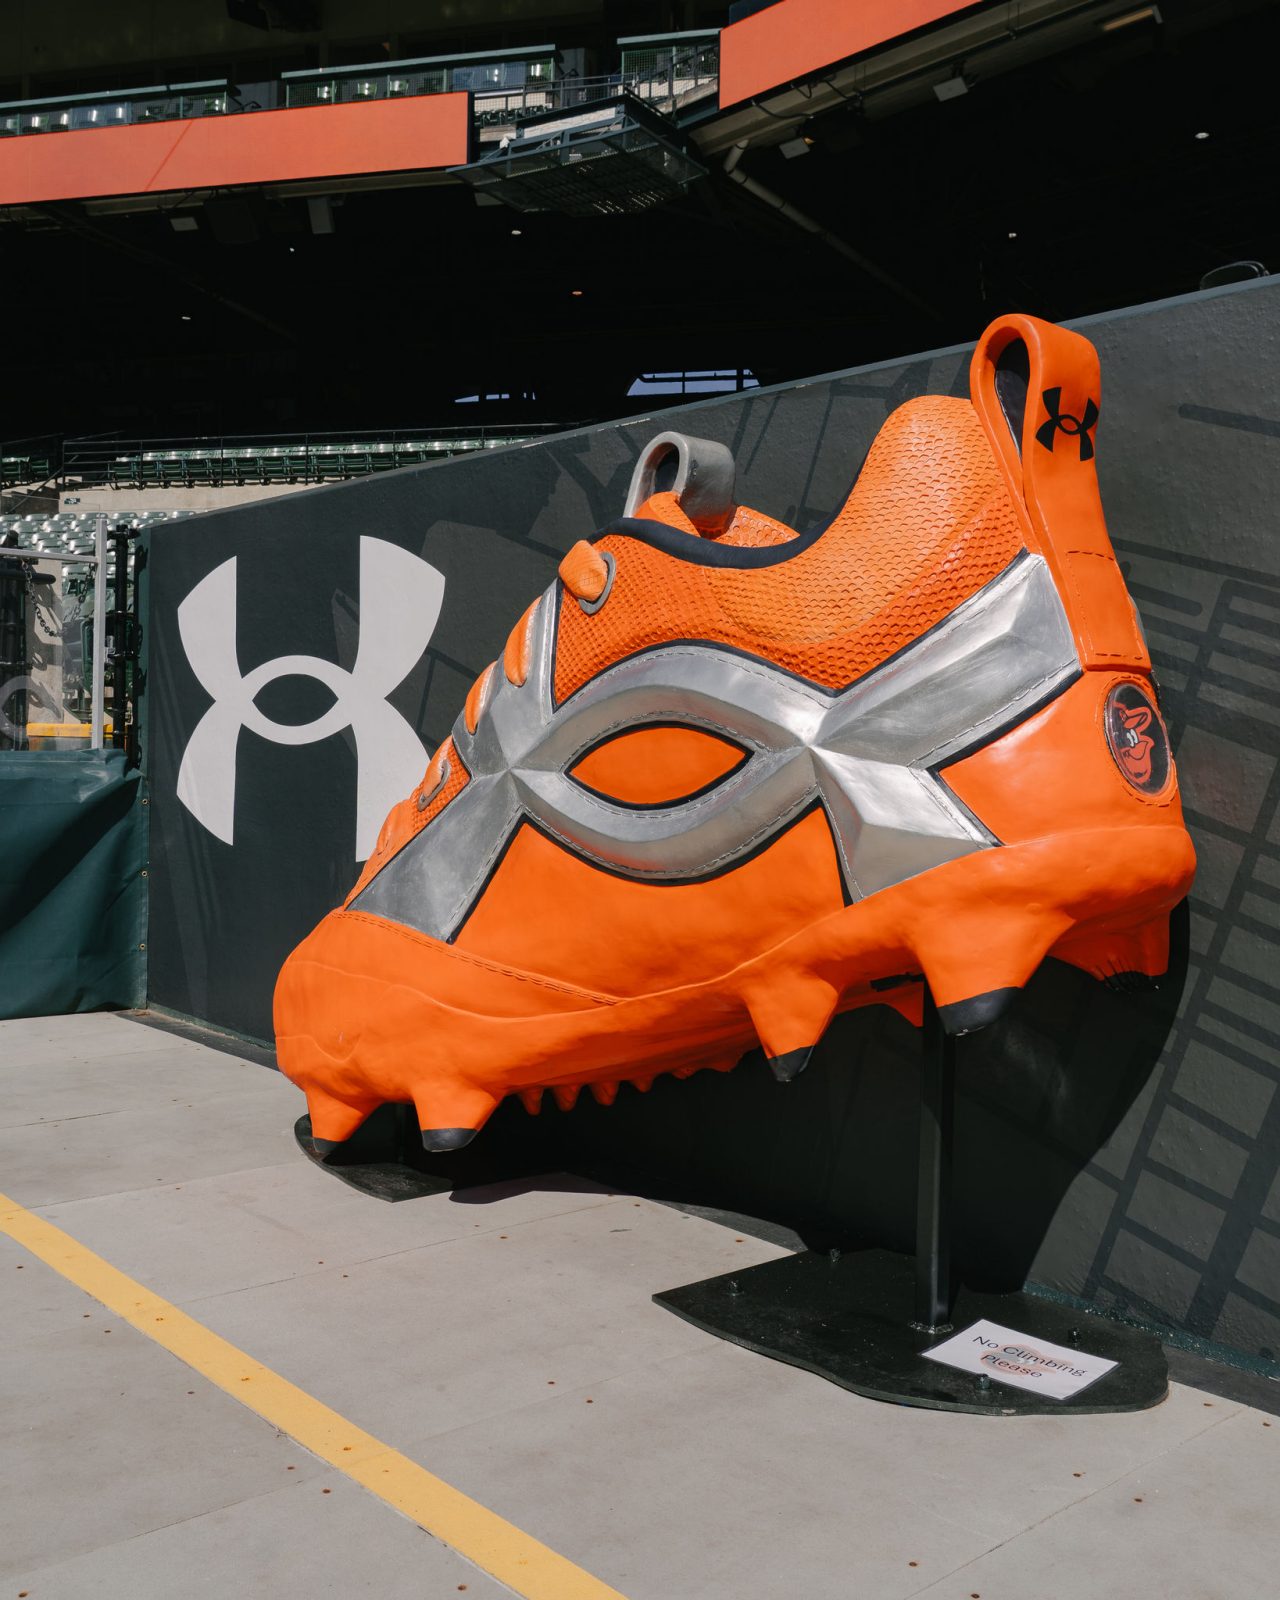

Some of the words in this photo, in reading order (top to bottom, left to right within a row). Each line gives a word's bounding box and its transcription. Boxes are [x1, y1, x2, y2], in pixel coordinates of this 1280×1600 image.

[973, 1336, 999, 1349] No
[1003, 1346, 1087, 1377] Climbing
[980, 1354, 1042, 1378] Please
